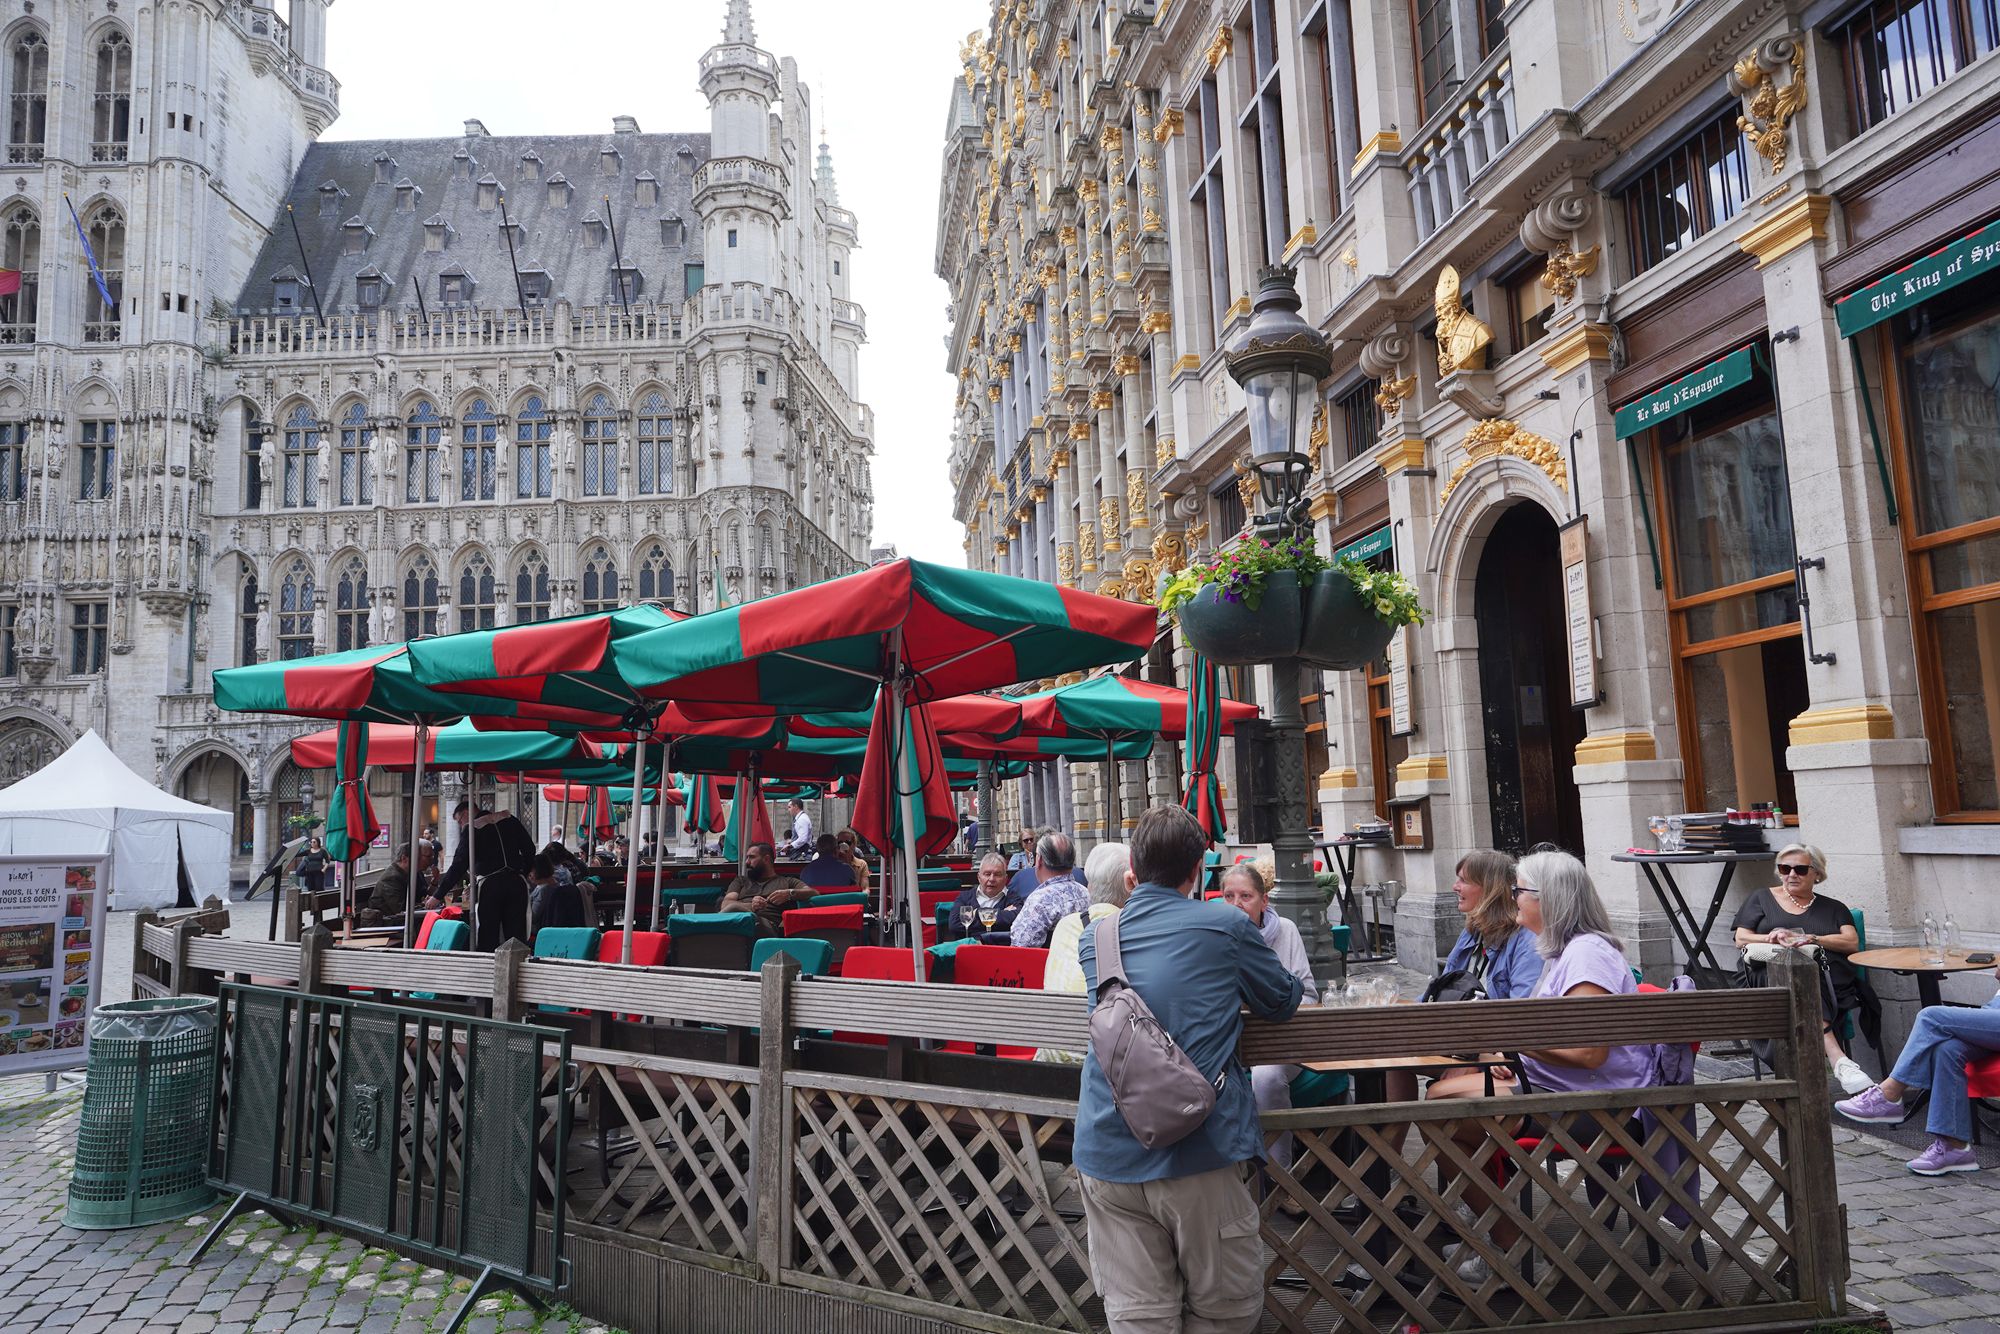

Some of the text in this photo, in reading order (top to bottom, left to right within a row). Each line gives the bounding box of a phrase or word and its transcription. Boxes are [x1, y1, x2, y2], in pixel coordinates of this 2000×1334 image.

[1870, 291, 1897, 312] The
[1903, 270, 1941, 297] King
[1946, 254, 1964, 276] of
[1637, 374, 1724, 422] Le Roy d'Espagne
[33, 894, 56, 903] GOÛTS
